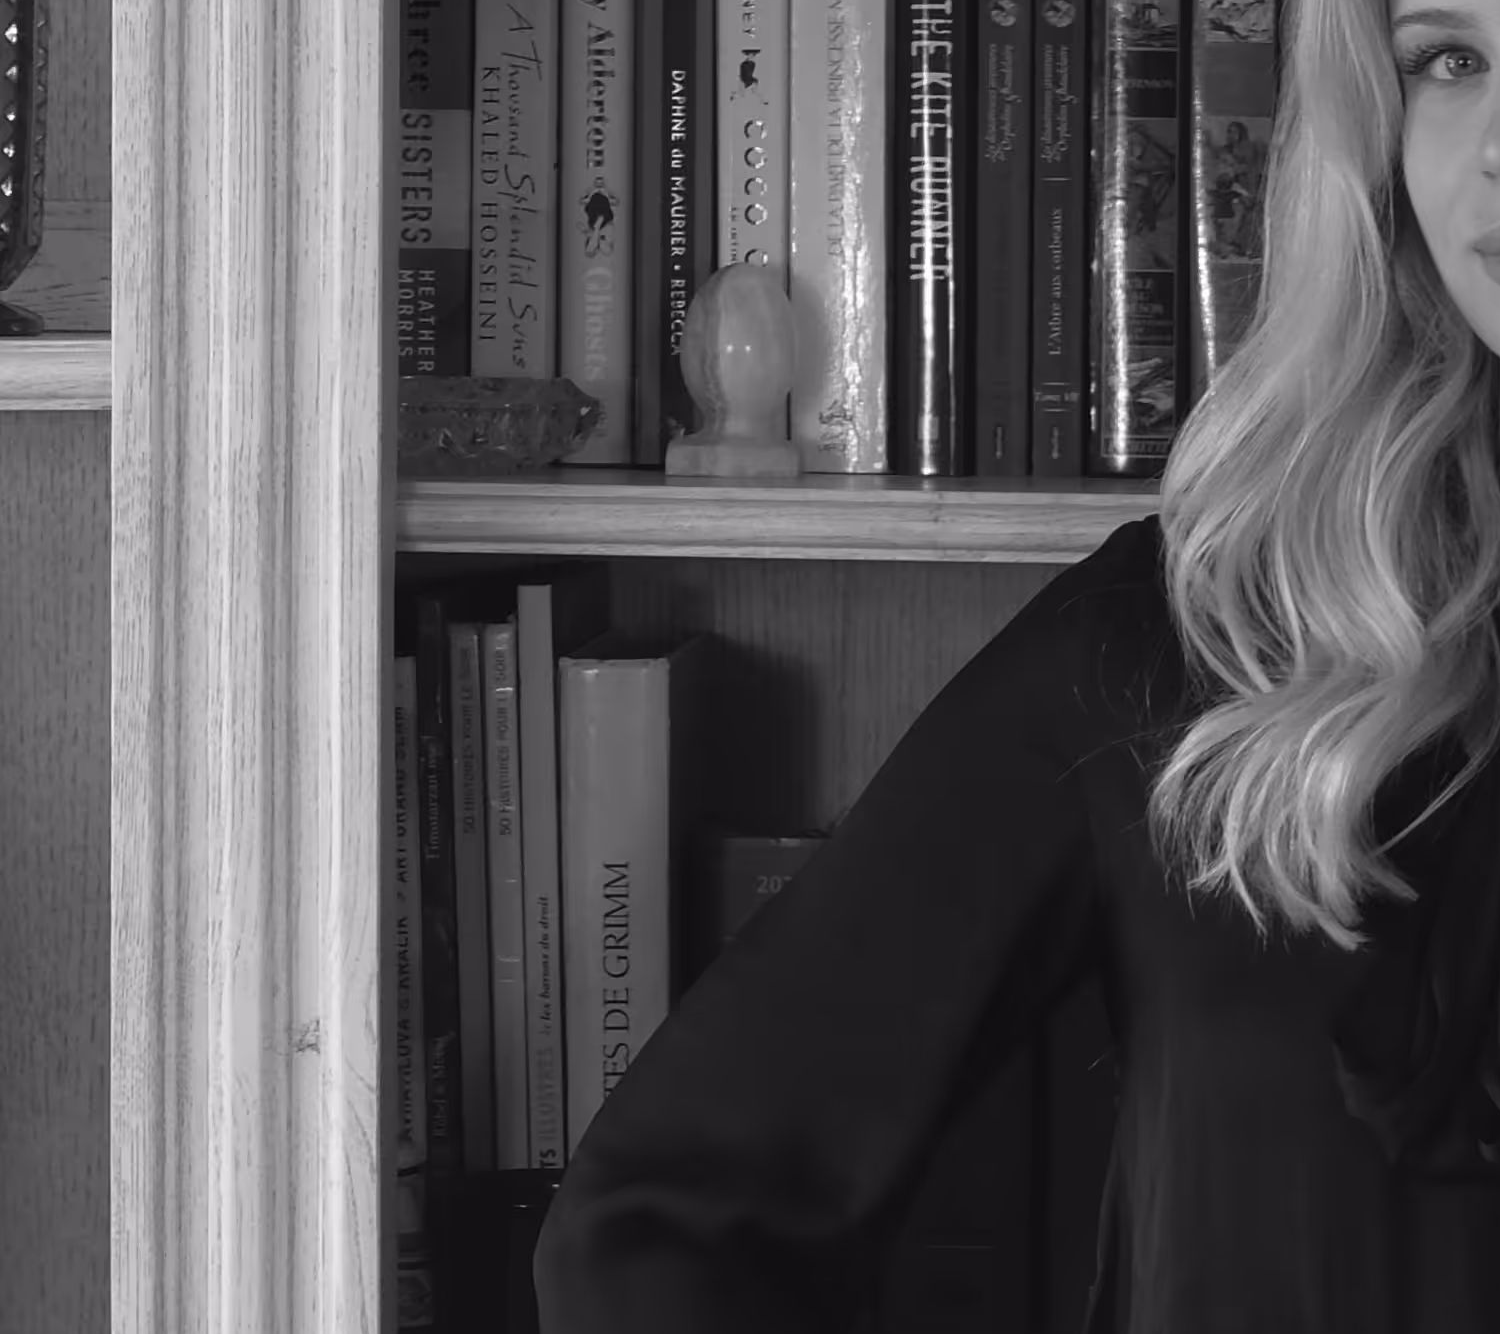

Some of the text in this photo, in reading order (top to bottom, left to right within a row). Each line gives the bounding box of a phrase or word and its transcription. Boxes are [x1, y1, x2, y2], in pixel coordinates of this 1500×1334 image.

[586, 20, 617, 170] Alderton
[827, 14, 845, 103] PRINCESSE
[827, 107, 845, 128] LA
[827, 132, 845, 157] DE
[910, 0, 953, 282] THE KITE RUNNER
[401, 113, 434, 245] SISTERS
[480, 66, 500, 342] KHALED HOSSEINI
[497, 3, 543, 369] A Thousand Splendid Suns
[670, 69, 687, 356] DAPHNE du MAURIER REBECCA
[827, 160, 845, 203] PART
[827, 206, 845, 227] LA
[827, 234, 845, 256] DE
[1046, 206, 1062, 356] L'Arbre aux corbeaux
[399, 269, 415, 358] MORRIS
[417, 269, 436, 373] HEATHER
[584, 267, 617, 382] Ghosts
[498, 818, 511, 837] 50
[537, 896, 551, 930] droit
[538, 932, 551, 949] du
[602, 861, 630, 1034] DE GRIMM
[539, 1002, 552, 1021] les
